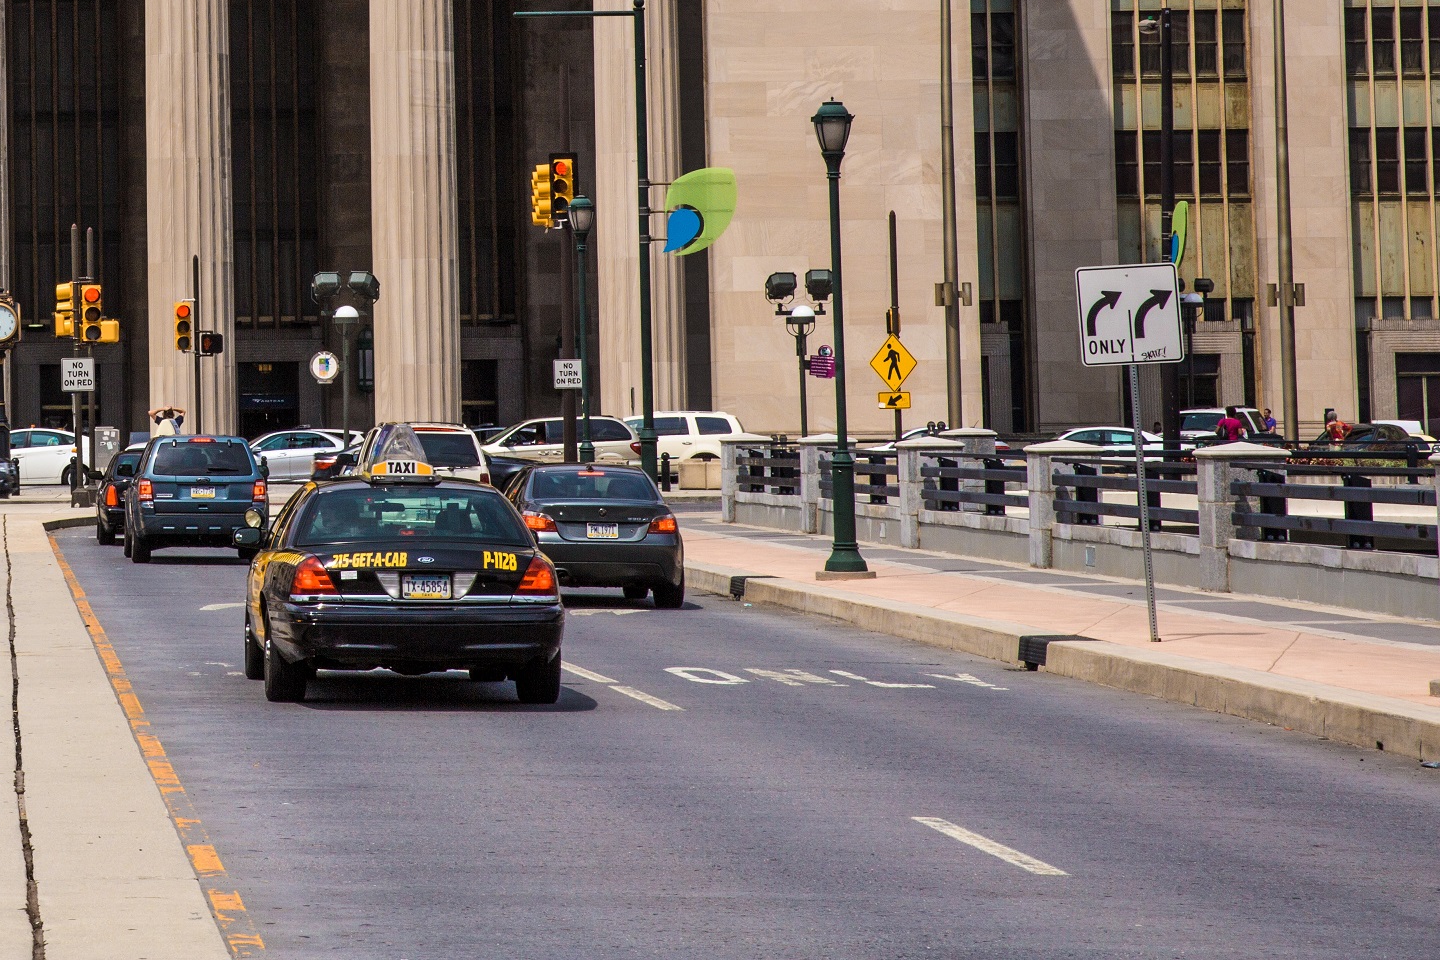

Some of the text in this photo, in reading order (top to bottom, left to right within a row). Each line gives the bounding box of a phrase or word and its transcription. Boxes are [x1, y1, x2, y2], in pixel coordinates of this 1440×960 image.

[1089, 339, 1126, 355] ONLY
[72, 361, 83, 369] NO
[563, 362, 574, 370] NO
[67, 370, 89, 378] TURN
[64, 379, 75, 387] ON
[388, 462, 415, 473] TAXI
[332, 552, 408, 569] 215-GET-A-CAB
[483, 551, 517, 571] P-1128
[405, 580, 448, 593] TX-45854
[663, 666, 1010, 690] ONLY
